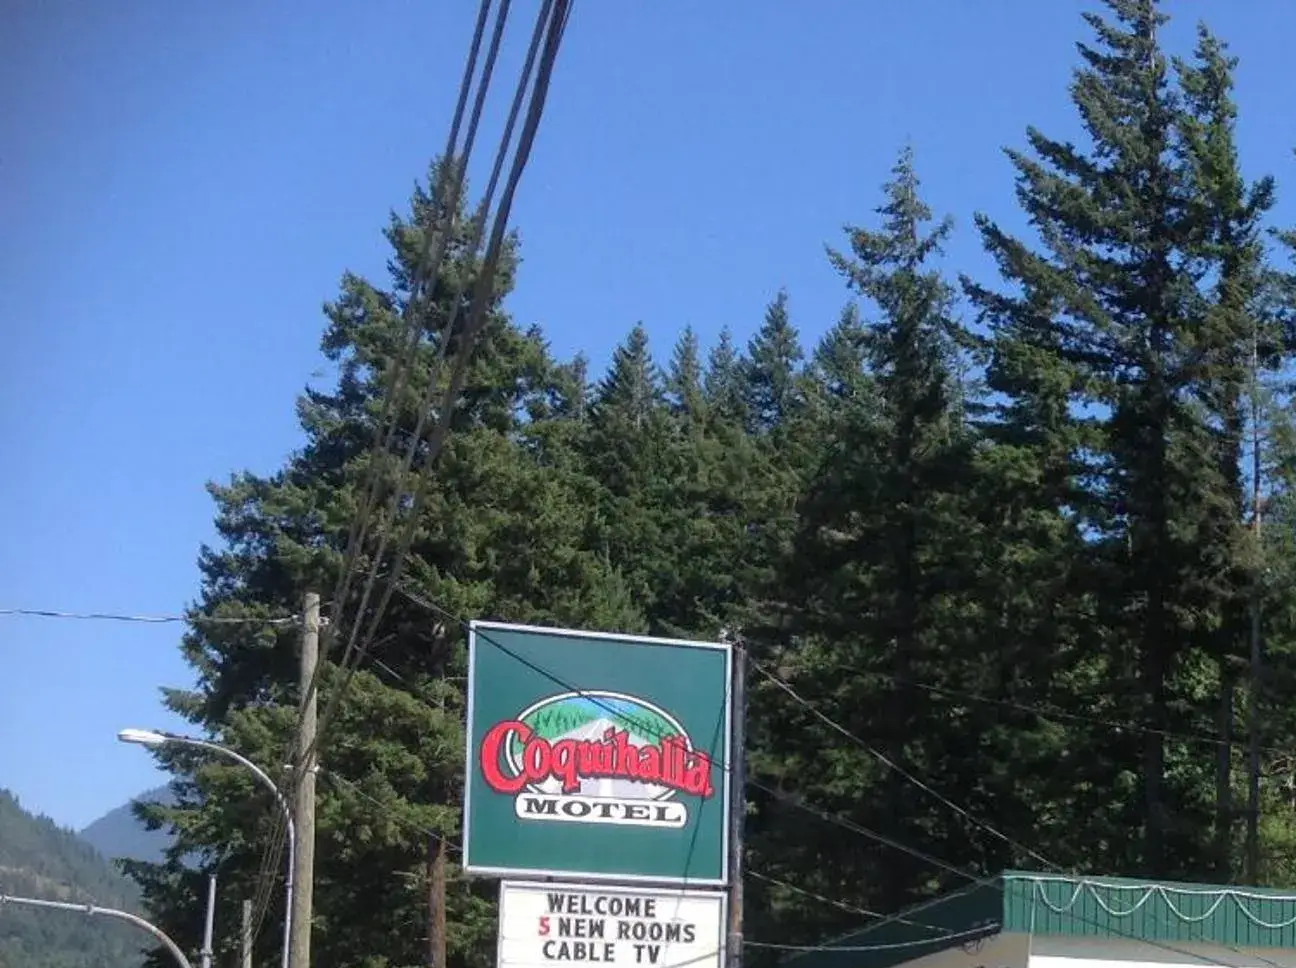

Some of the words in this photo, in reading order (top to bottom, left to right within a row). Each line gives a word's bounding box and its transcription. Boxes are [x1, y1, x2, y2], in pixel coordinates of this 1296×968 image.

[480, 720, 713, 797] Coquihalla
[523, 797, 683, 823] MOTEL
[546, 893, 656, 918] WELCOME
[538, 916, 550, 936] 5
[558, 917, 605, 939] NEW
[617, 919, 696, 943] ROOMS
[542, 940, 616, 963] CABLE
[632, 944, 661, 964] TV
